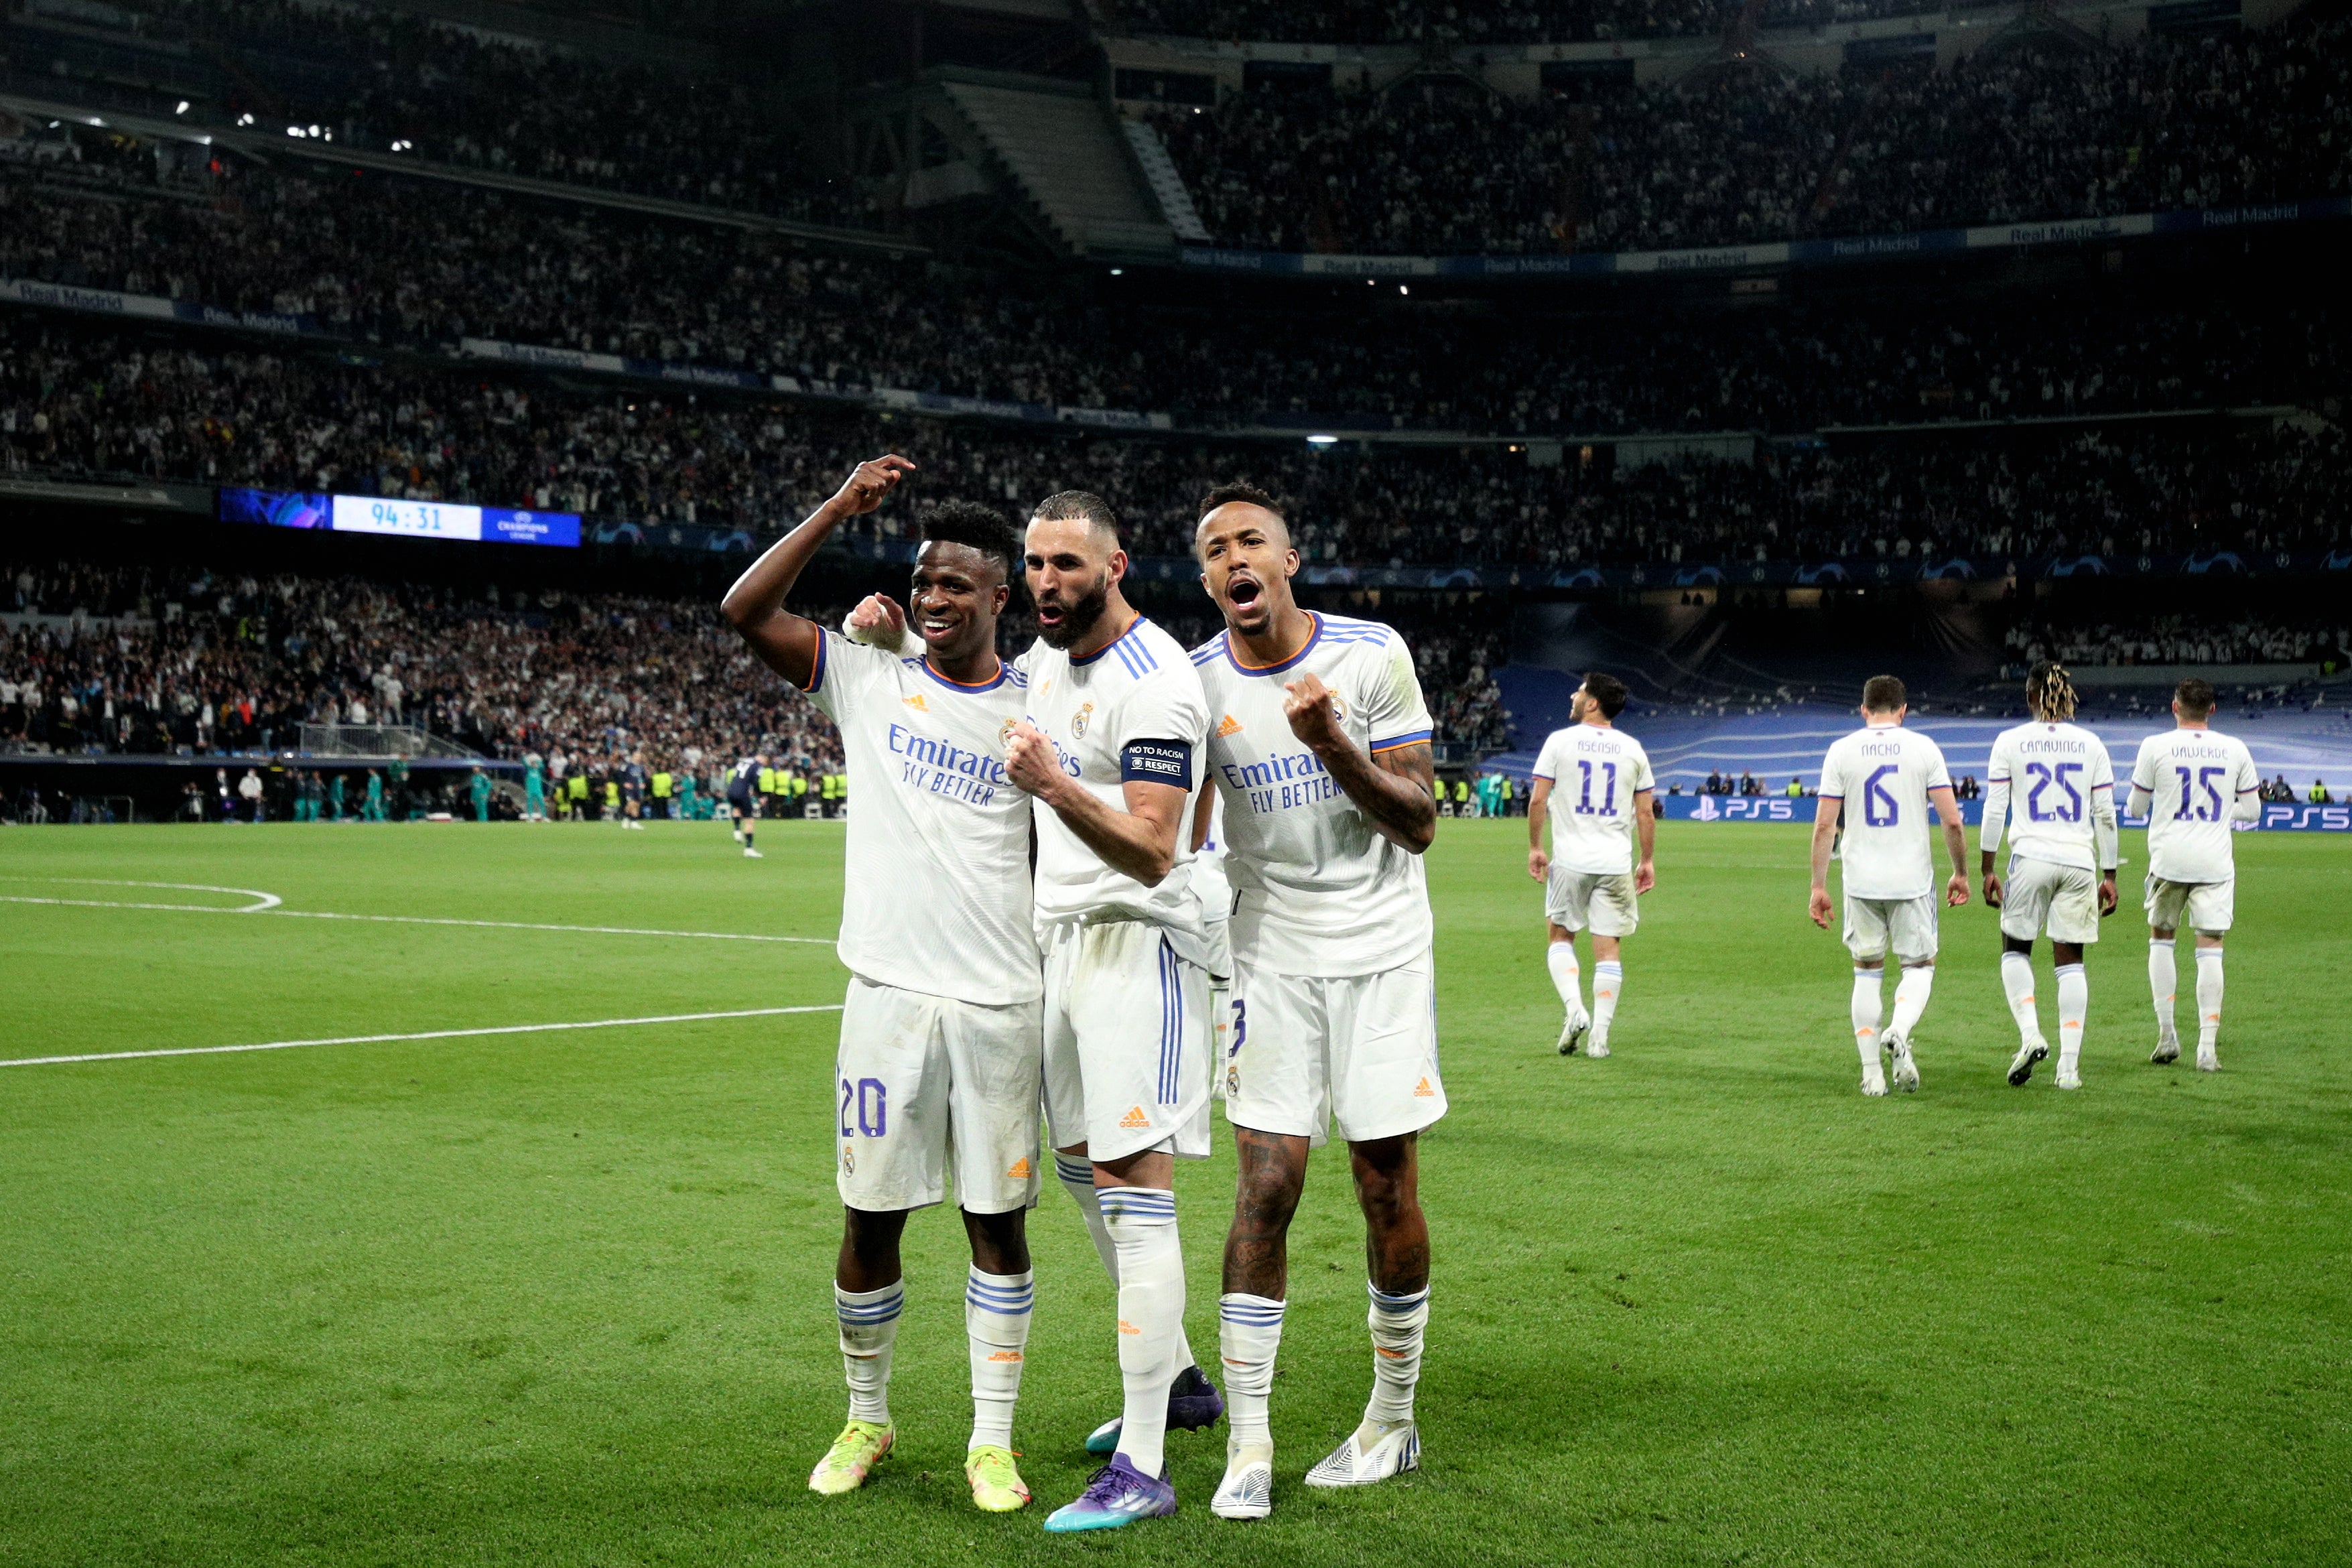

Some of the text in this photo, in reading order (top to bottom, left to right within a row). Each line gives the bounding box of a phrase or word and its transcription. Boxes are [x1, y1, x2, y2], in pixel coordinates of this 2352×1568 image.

[2203, 204, 2298, 226] Real Madrid
[1834, 237, 1919, 255] Real Madrid
[2011, 228, 2044, 243] Real
[1658, 250, 1747, 269] Real Madrid
[371, 503, 441, 531] 94:31
[1128, 746, 1184, 760] NO TO RACISM
[1578, 739, 1621, 755] ASENSIO
[1861, 743, 1900, 757] NACHO
[2020, 740, 2085, 754] CAMAVINGA
[2172, 745, 2229, 761] VALVERDE
[1145, 760, 1181, 773] RESPECT
[930, 772, 994, 806] BETTER
[1575, 760, 1618, 817] 11
[1864, 765, 1899, 828] 6
[2025, 762, 2083, 823] 25
[2173, 766, 2226, 822] 15
[1250, 790, 1274, 813] FLY
[1725, 799, 1793, 820] PS5
[2266, 806, 2350, 830] PS5
[842, 1077, 887, 1138] 20
[1119, 1120, 1150, 1128] adidas
